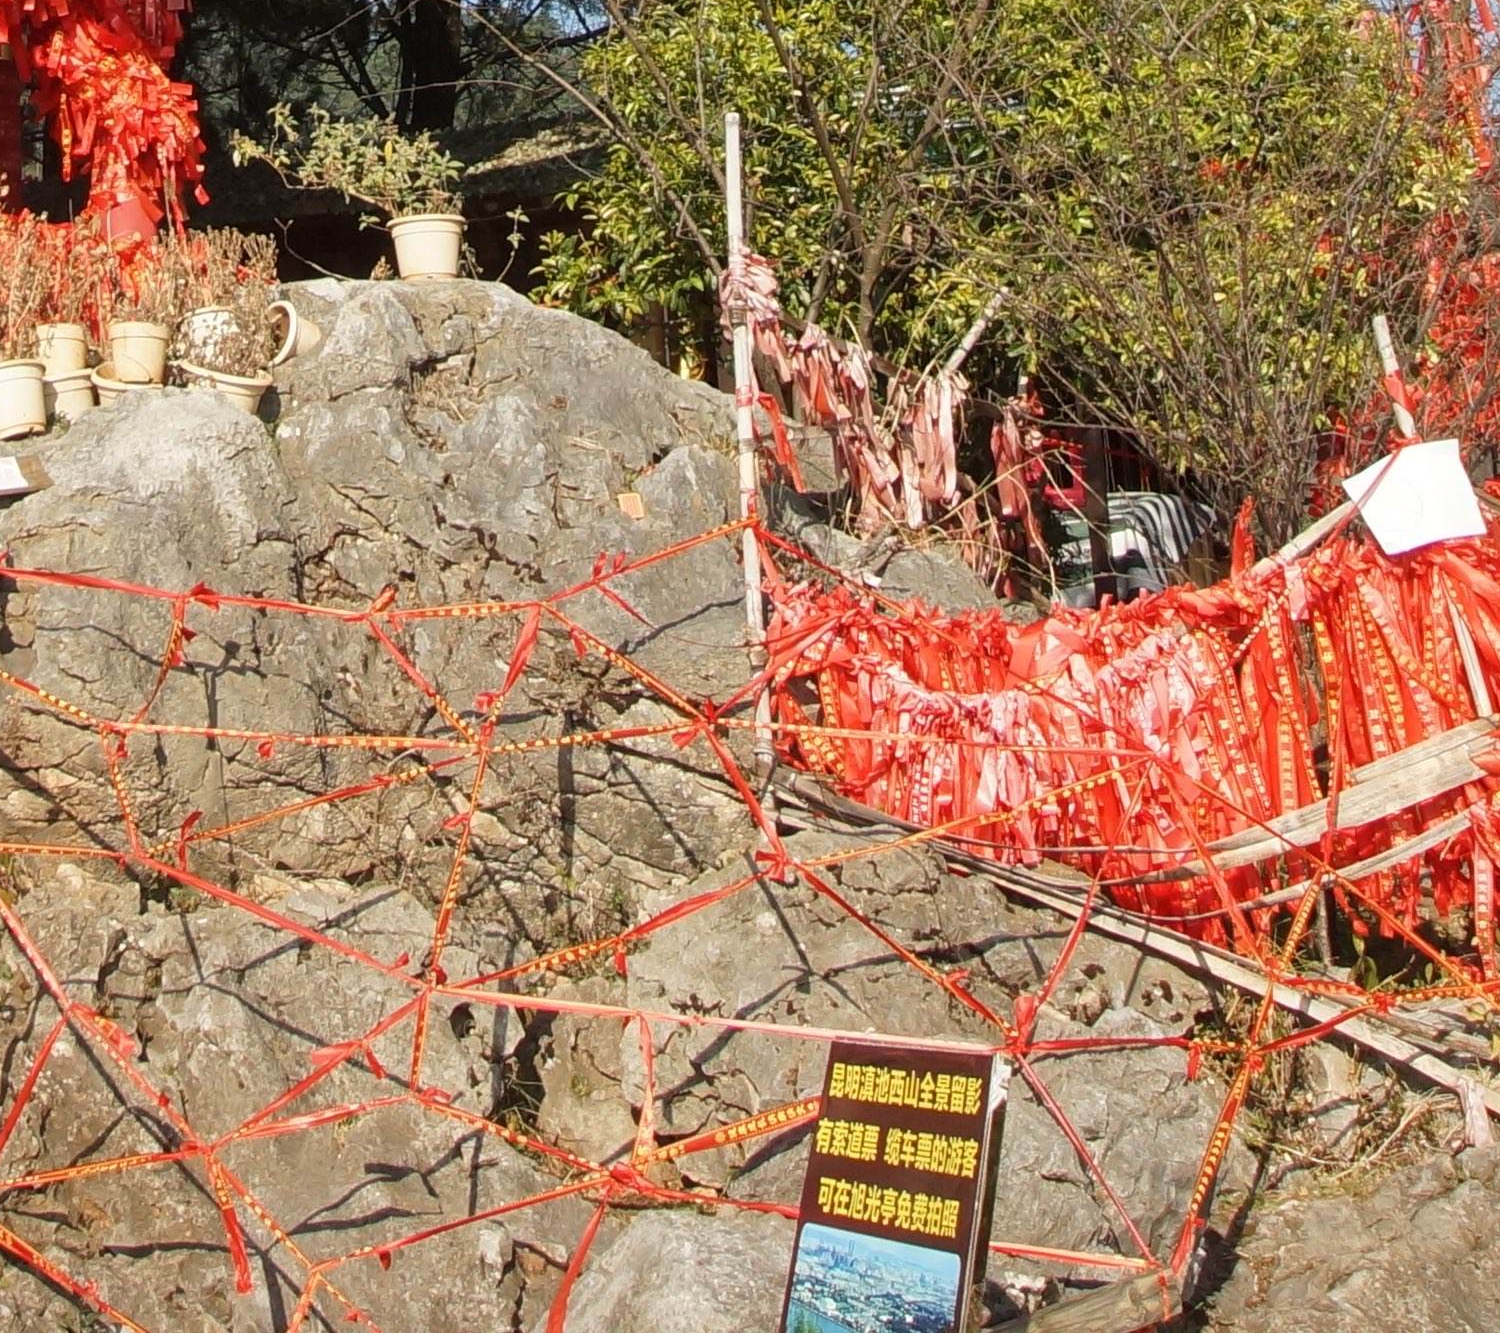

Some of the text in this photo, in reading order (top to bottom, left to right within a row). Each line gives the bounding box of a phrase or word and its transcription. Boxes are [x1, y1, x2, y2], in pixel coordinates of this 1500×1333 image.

[828, 1062, 983, 1115] 昆明滇池西山全景留影
[815, 1118, 881, 1162] 有索道票
[884, 1127, 979, 1179] 缆车票的游客
[817, 1177, 961, 1238] 可在旭光亭免费拍照
